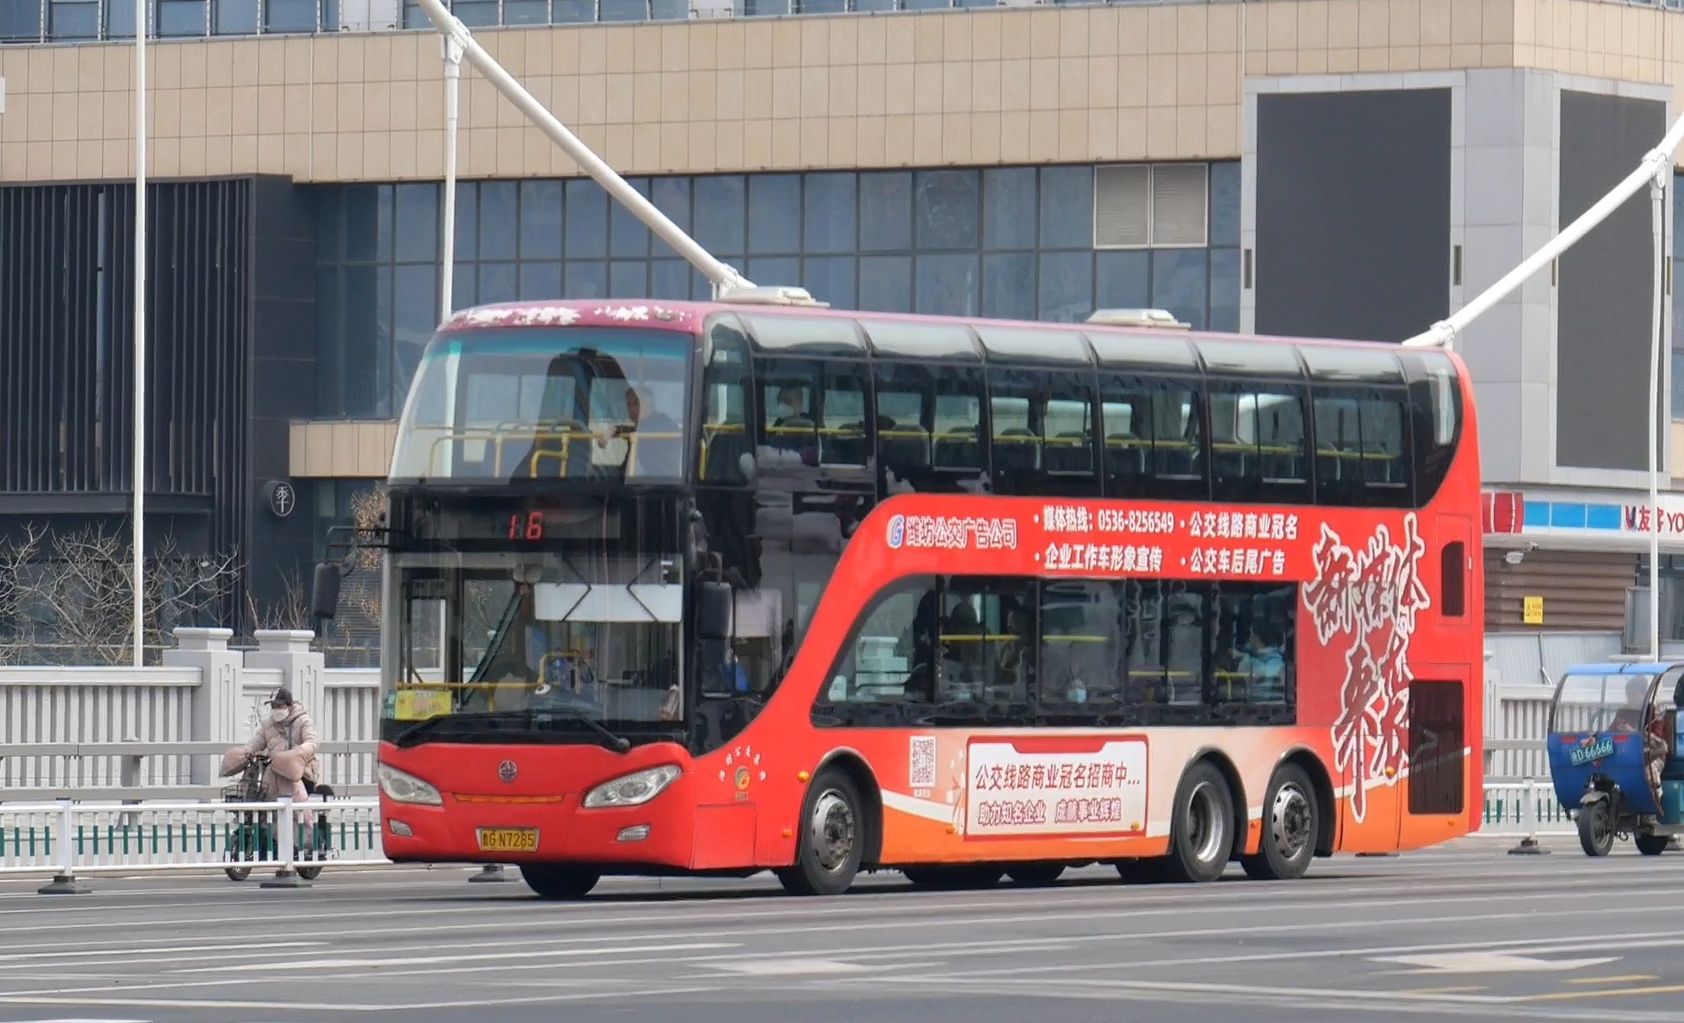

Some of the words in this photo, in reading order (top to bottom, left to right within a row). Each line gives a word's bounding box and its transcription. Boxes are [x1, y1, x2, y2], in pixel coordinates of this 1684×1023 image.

[508, 511, 544, 540] 16
[1189, 510, 1299, 540] 公交线路商业冠名
[1044, 542, 1163, 572] 企业工作车形象宣传
[1190, 547, 1286, 576] 公交车后尾广告
